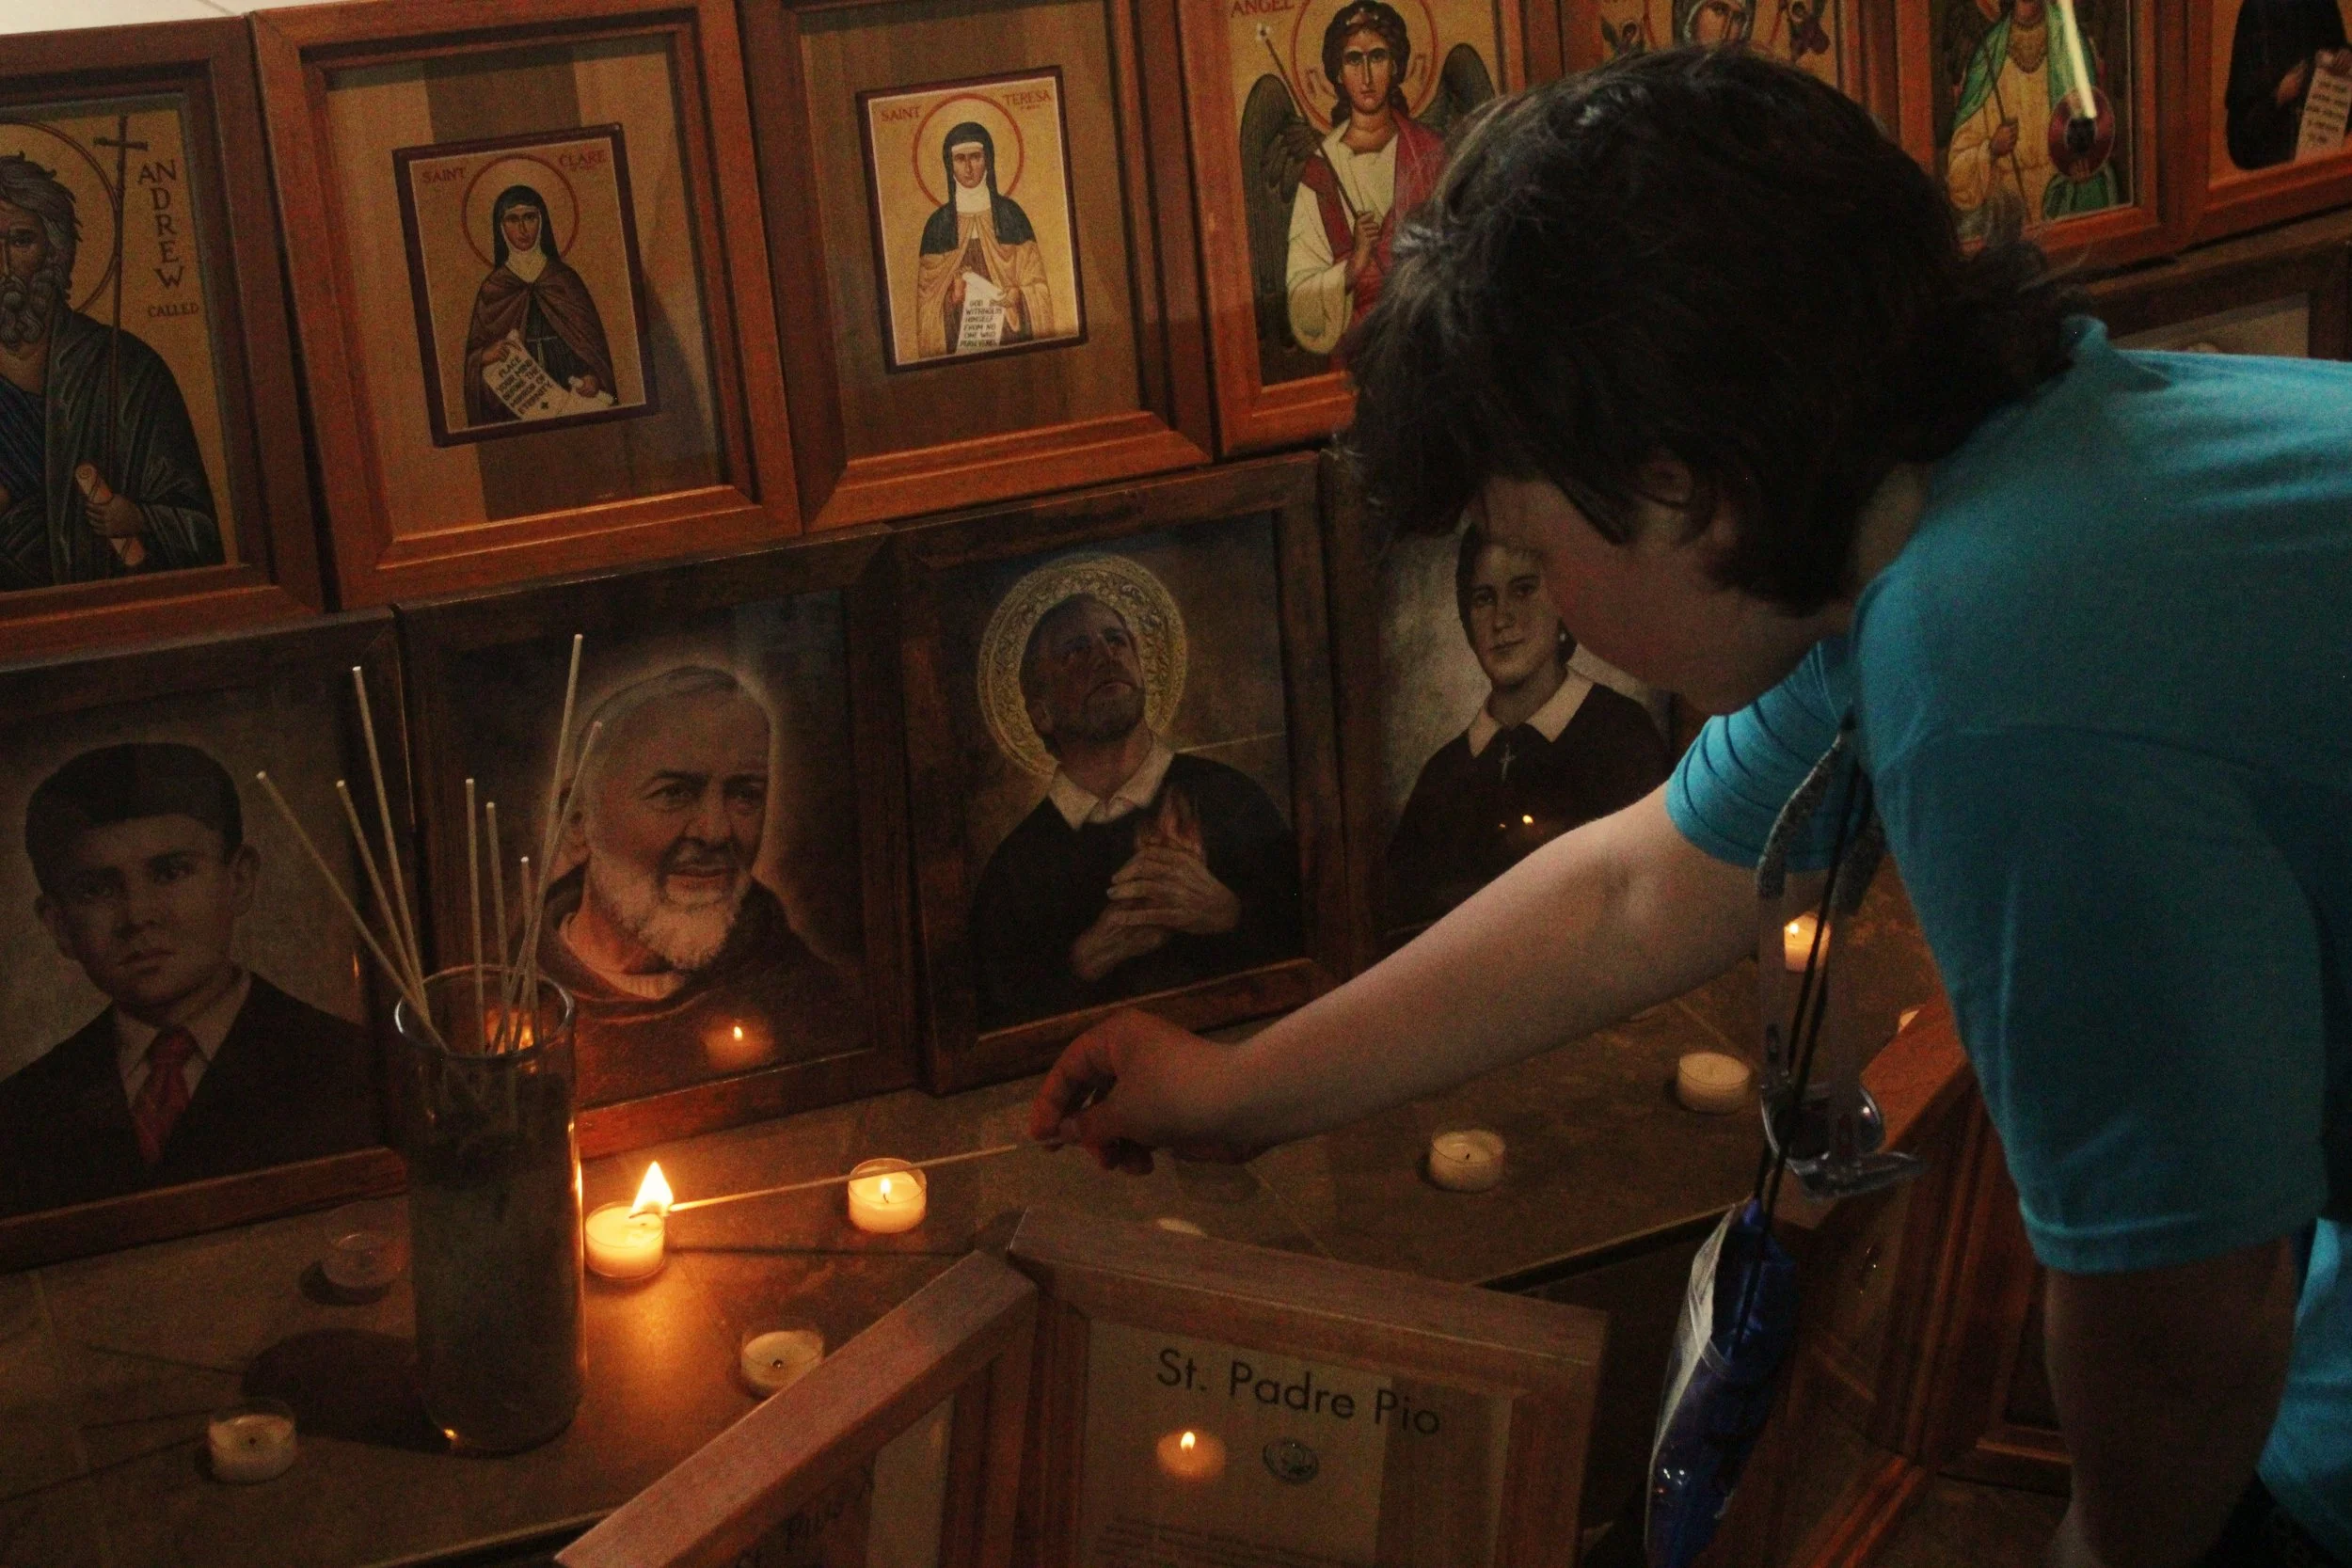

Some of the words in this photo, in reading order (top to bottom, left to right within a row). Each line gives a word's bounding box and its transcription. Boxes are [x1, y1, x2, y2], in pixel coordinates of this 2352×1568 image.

[1231, 0, 1295, 18] ANGEL
[882, 105, 923, 122] SAINT
[1003, 89, 1052, 105] TERESA
[422, 166, 467, 183] SAINT
[559, 150, 607, 170] CLARE
[147, 302, 199, 318] CALLED
[1156, 1347, 1207, 1393] St.
[1229, 1360, 1356, 1419] Padre
[1374, 1388, 1440, 1436] Pio
